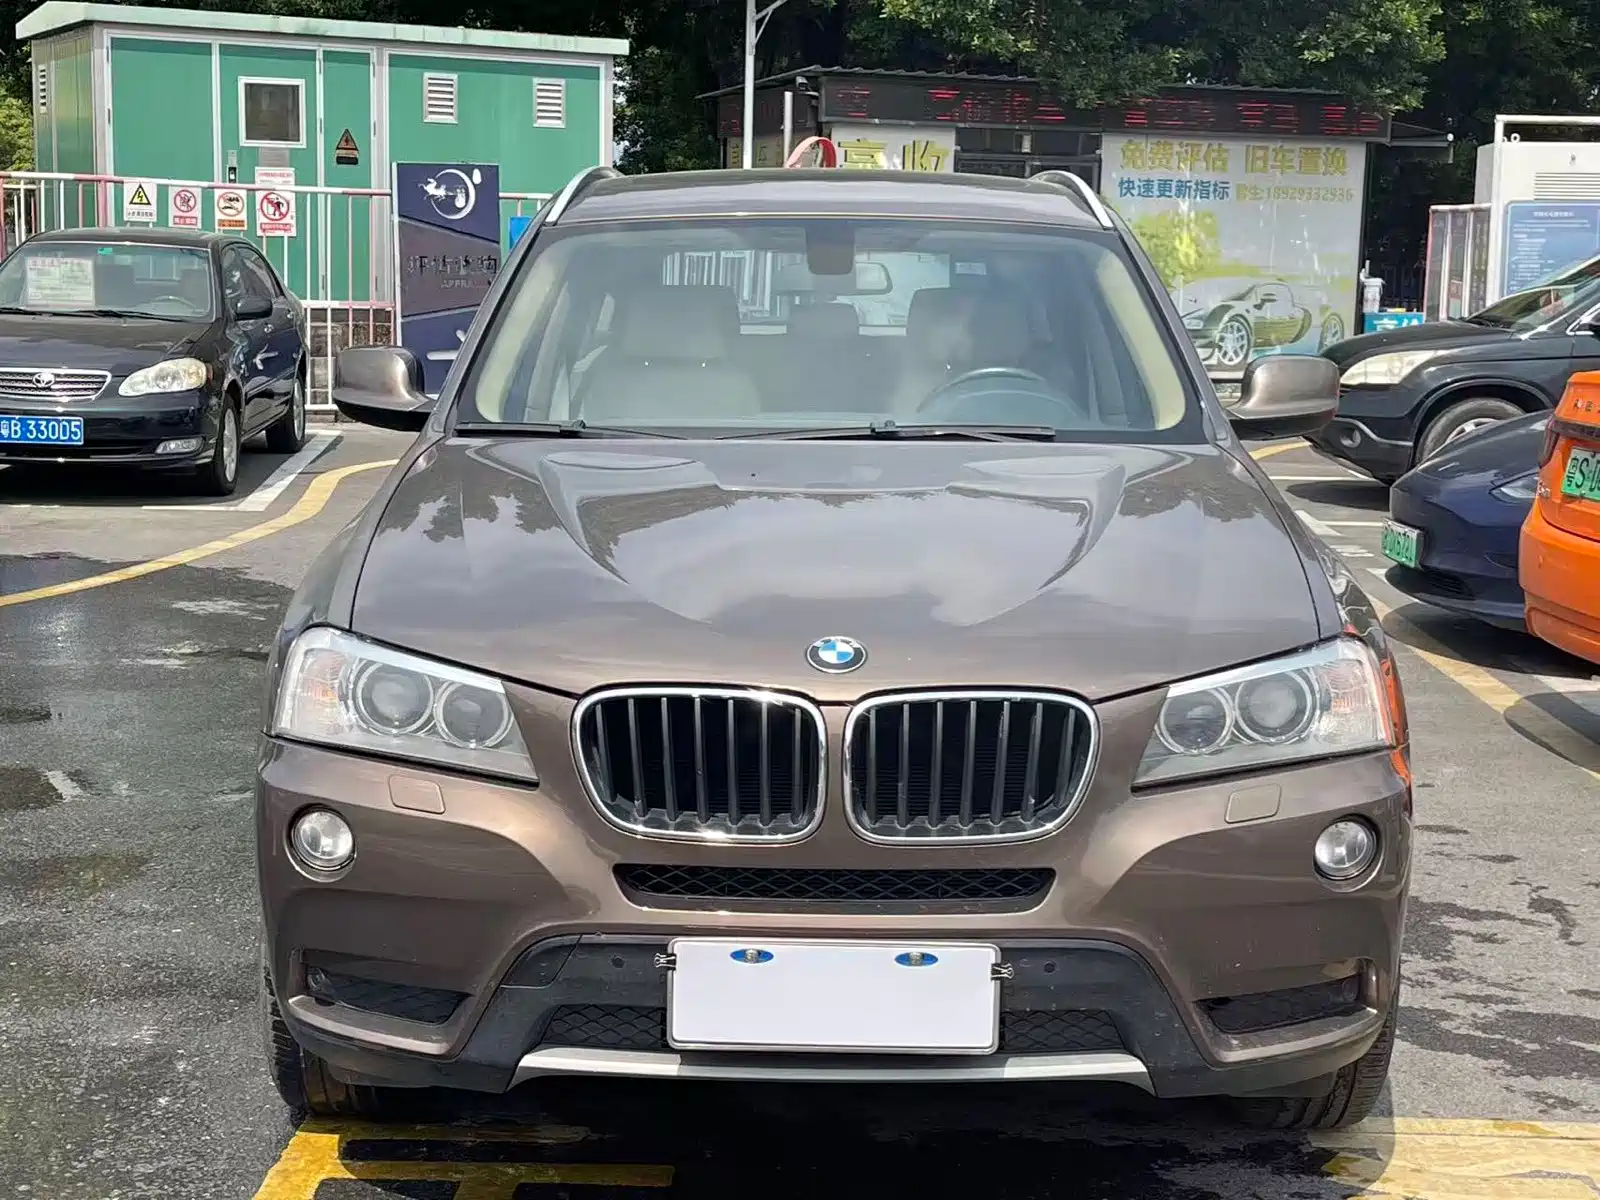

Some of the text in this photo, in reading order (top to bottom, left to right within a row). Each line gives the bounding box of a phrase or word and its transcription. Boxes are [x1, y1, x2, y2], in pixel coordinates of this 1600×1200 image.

[1120, 139, 1348, 176] 免费评估 旧车置换
[1118, 177, 1230, 200] 快速更新指标
